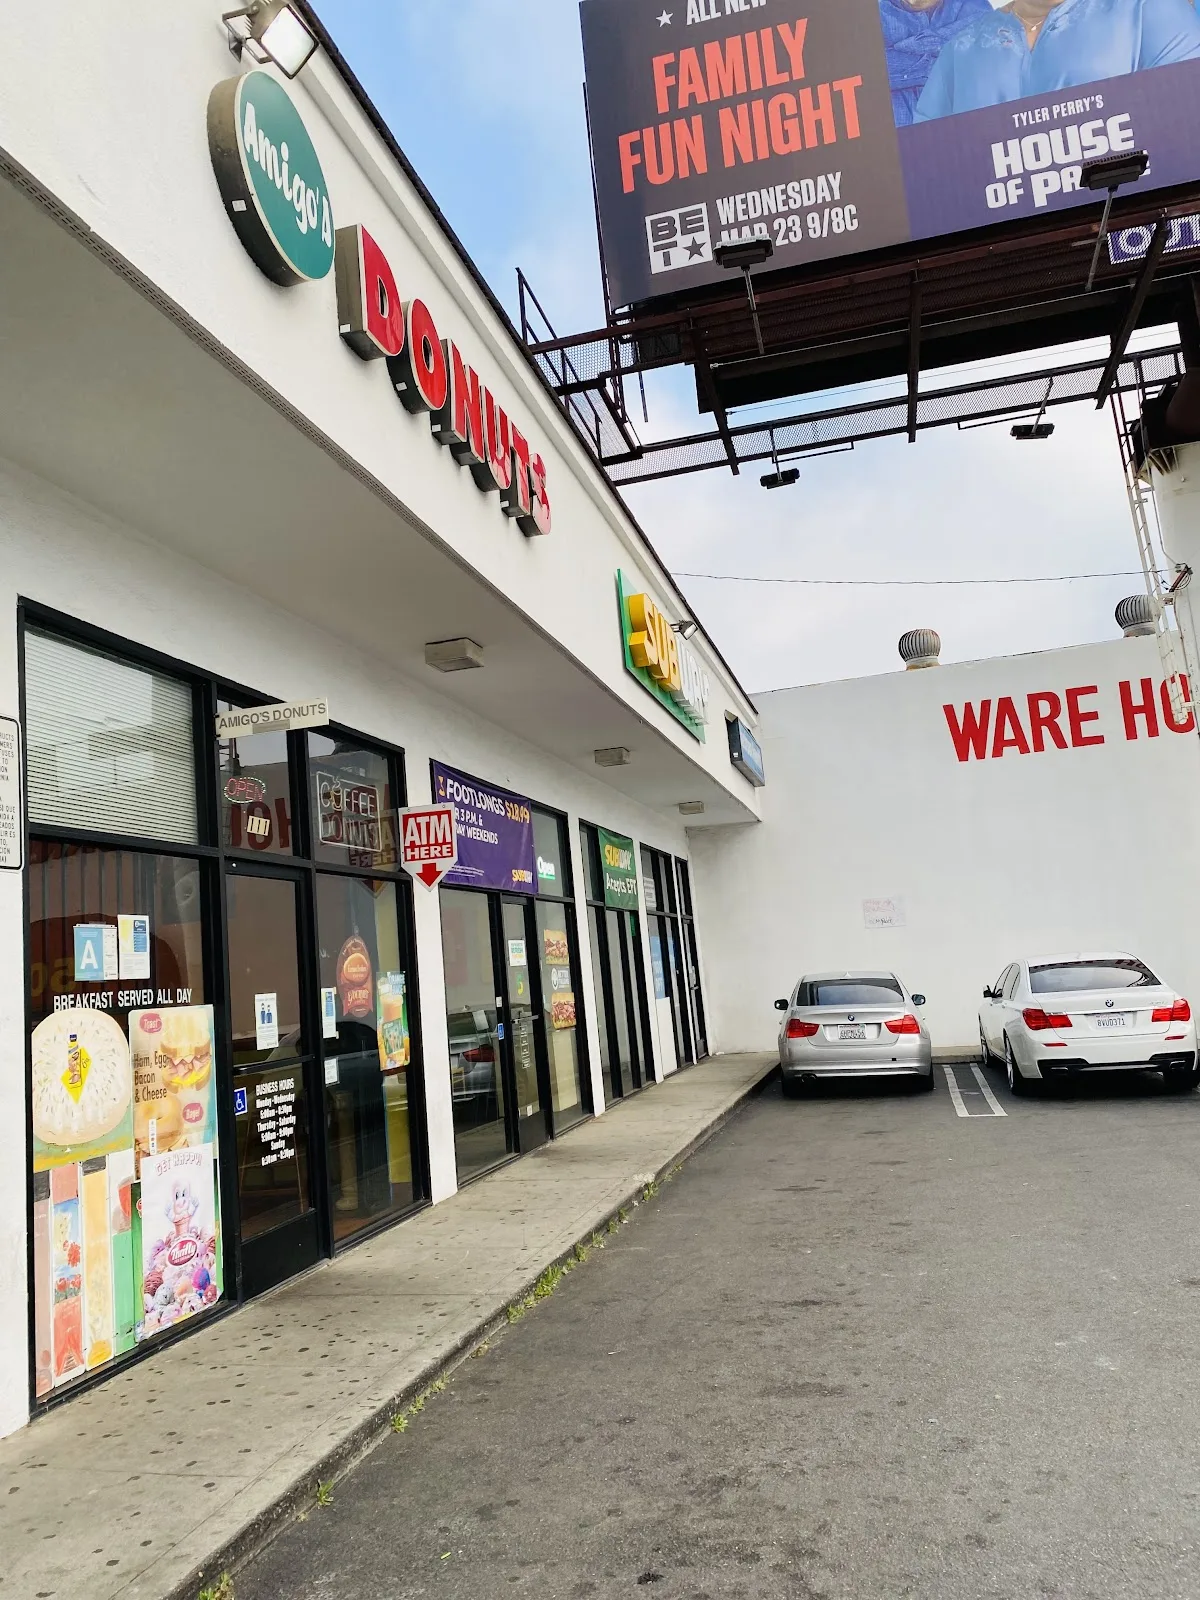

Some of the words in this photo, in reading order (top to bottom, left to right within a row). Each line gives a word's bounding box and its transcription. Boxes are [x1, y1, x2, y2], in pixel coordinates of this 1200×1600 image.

[652, 17, 808, 114] FAMILY
[1012, 106, 1050, 128] TYLER
[1053, 94, 1104, 119] PERRY'S
[618, 114, 708, 194] FUN
[718, 75, 863, 168] NIGHT
[991, 112, 1135, 179] HOUSE
[716, 171, 842, 226] WEDNESDAY
[985, 177, 1024, 209] OF
[773, 214, 803, 247] 23
[806, 204, 859, 239] 9/8C
[336, 224, 552, 537] DONUTS
[628, 592, 710, 726] SUBWAY
[218, 711, 270, 730] AMIGO'S
[273, 702, 327, 722] DONUTS
[943, 685, 1105, 763] WARE
[226, 777, 264, 802] OPEN
[446, 778, 506, 818] FOOTLONGS
[404, 814, 452, 847] ATM
[466, 825, 498, 845] WEEKENDS
[406, 845, 451, 861] HERE
[80, 939, 99, 970] A
[53, 991, 113, 1011] BREAKFAST
[117, 989, 154, 1007] SERVED
[156, 988, 174, 1005] ALL
[176, 988, 193, 1005] DAY
[134, 1070, 156, 1086] Bacon
[256, 1080, 278, 1097] BUSINESS
[279, 1077, 295, 1091] HOURS
[134, 1088, 140, 1104] &
[142, 1085, 168, 1102] Cheese
[271, 1138, 286, 1151] Sunday
